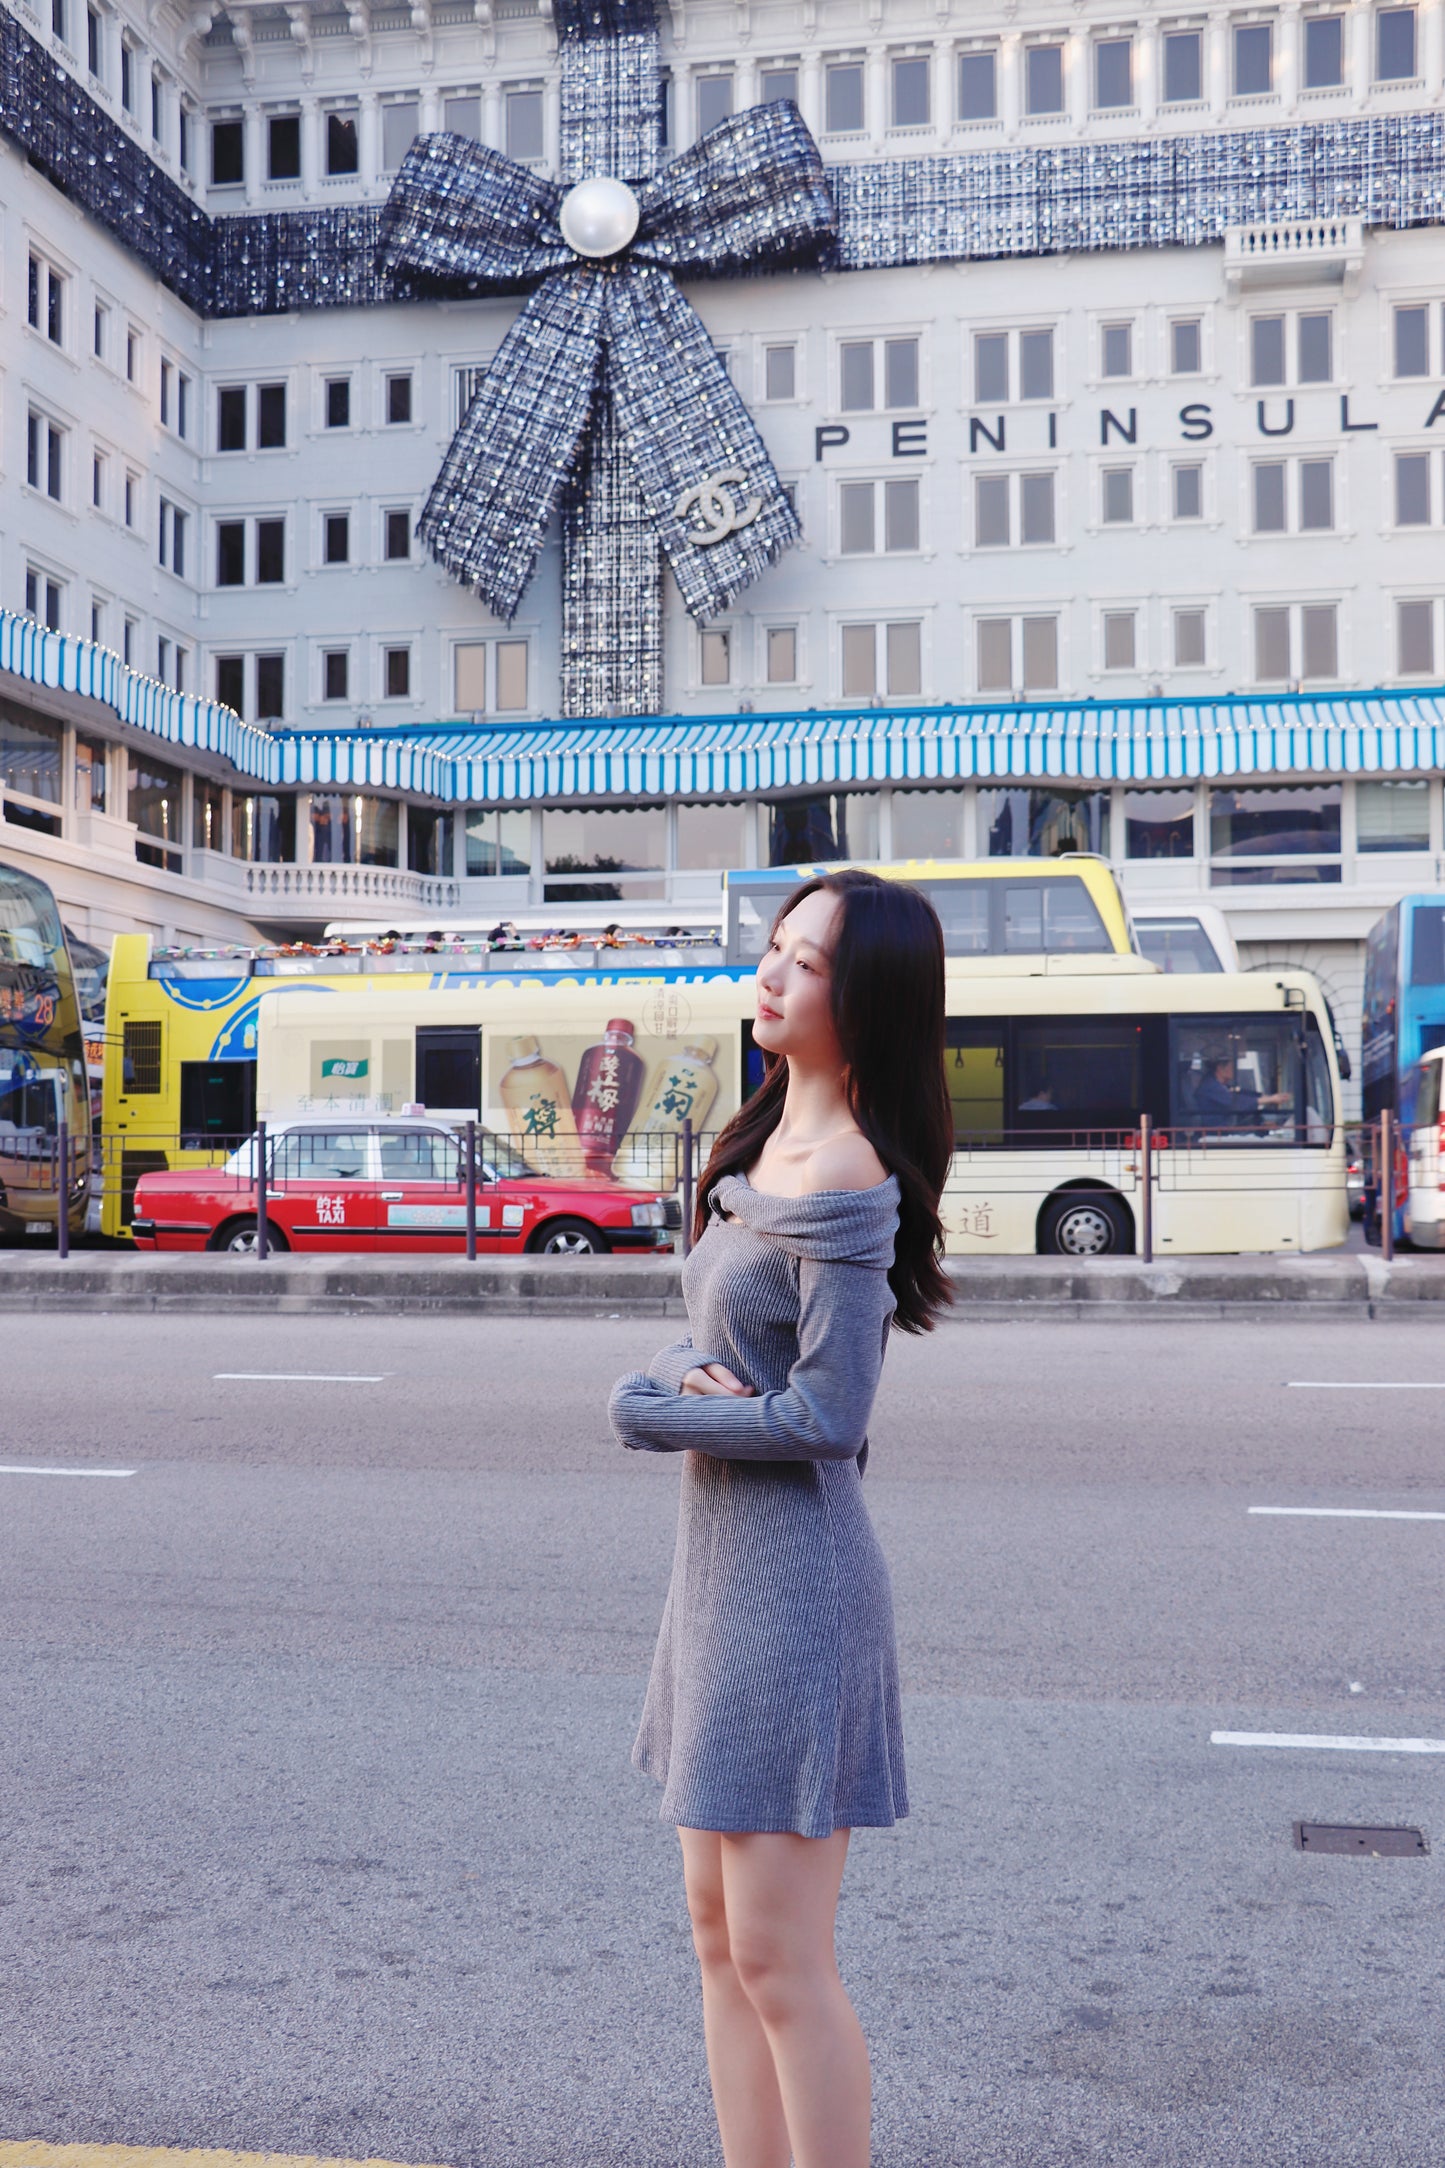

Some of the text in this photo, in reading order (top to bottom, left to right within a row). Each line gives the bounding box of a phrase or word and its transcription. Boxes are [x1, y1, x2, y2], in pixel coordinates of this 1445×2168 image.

[34, 994, 54, 1025] 28
[316, 1196, 345, 1209] 的士
[316, 1210, 345, 1224] TAXI
